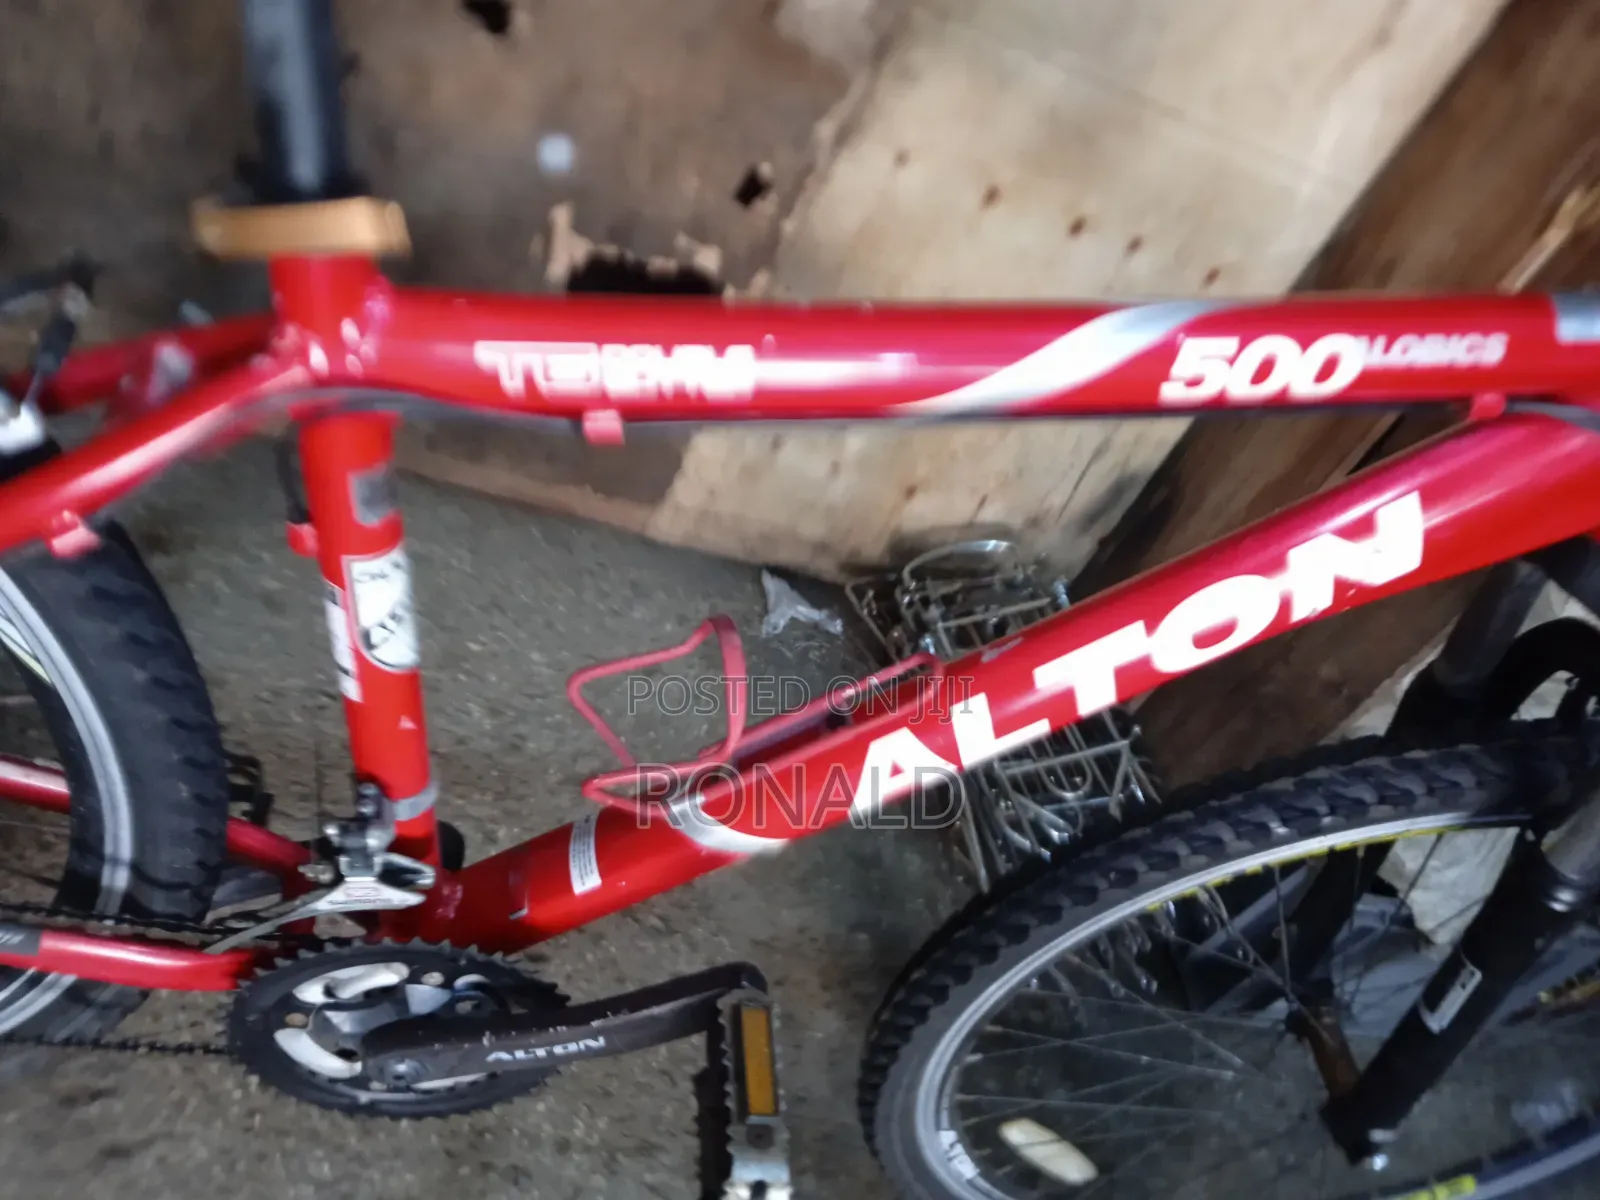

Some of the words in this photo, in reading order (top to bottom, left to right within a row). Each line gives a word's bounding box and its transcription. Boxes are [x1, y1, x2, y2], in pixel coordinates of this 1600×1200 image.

[1158, 333, 1366, 404] 500
[849, 490, 1424, 817] ALTON
[485, 1036, 606, 1062] ALTON
